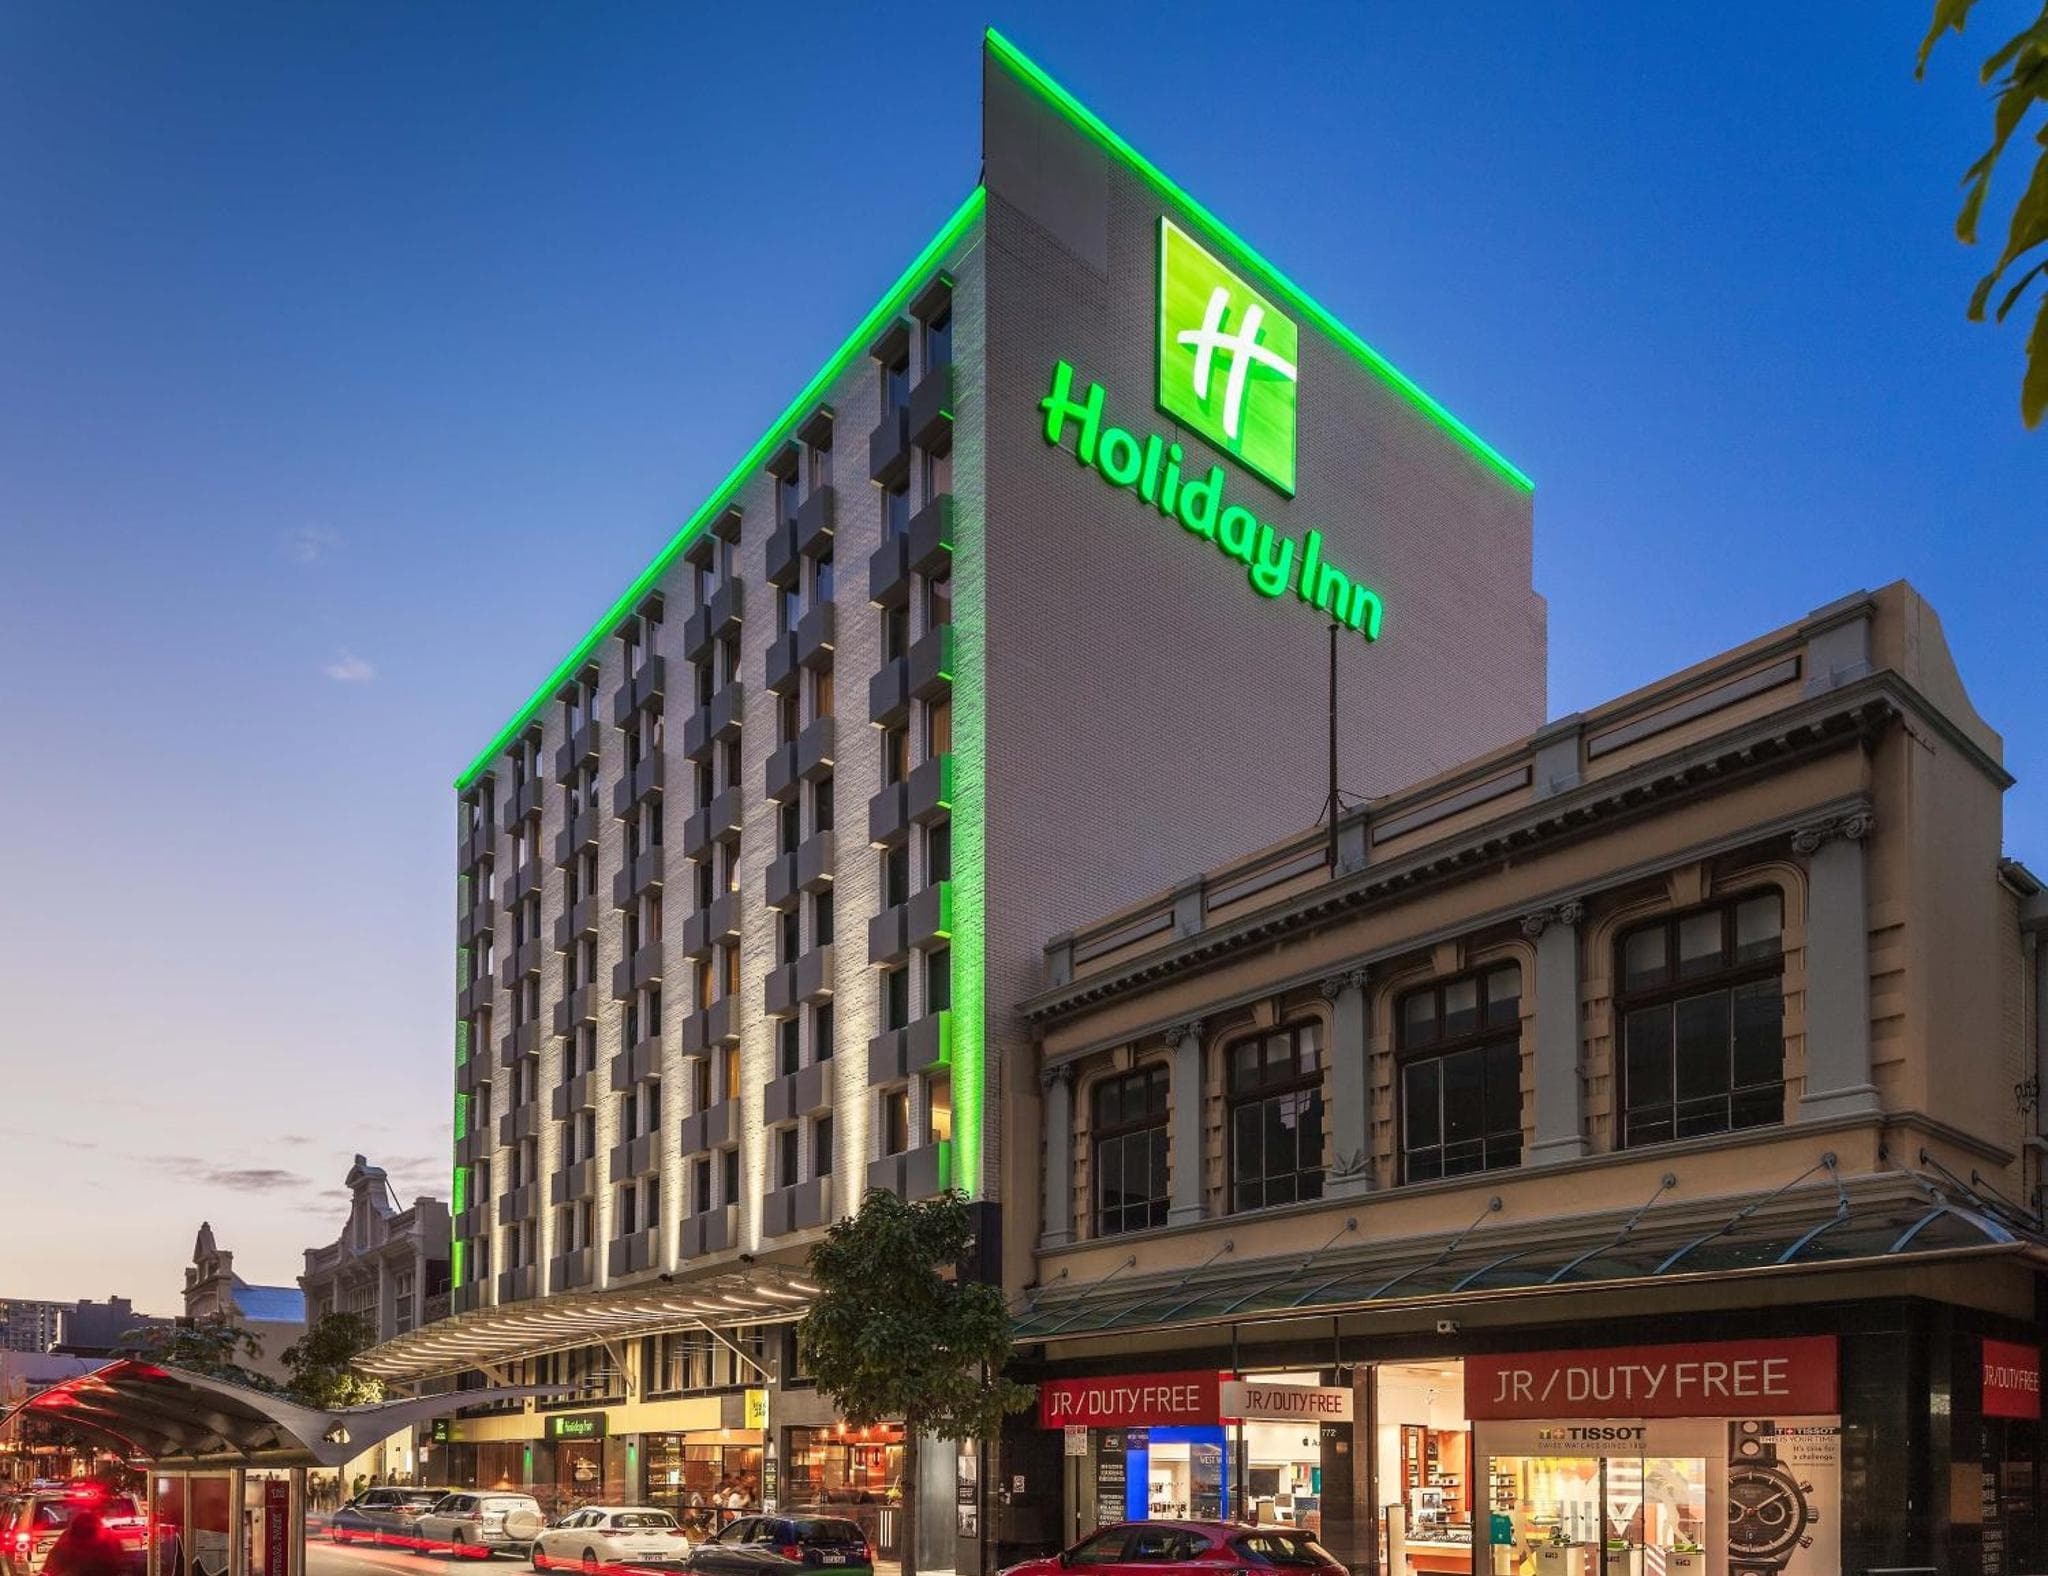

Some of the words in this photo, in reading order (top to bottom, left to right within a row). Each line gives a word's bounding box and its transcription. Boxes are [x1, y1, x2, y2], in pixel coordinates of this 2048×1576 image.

[1038, 360, 1294, 598] Holiday
[1298, 530, 1385, 642] Inn
[1321, 1429, 1336, 1437] 772
[1567, 1427, 1646, 1440] TISSOT
